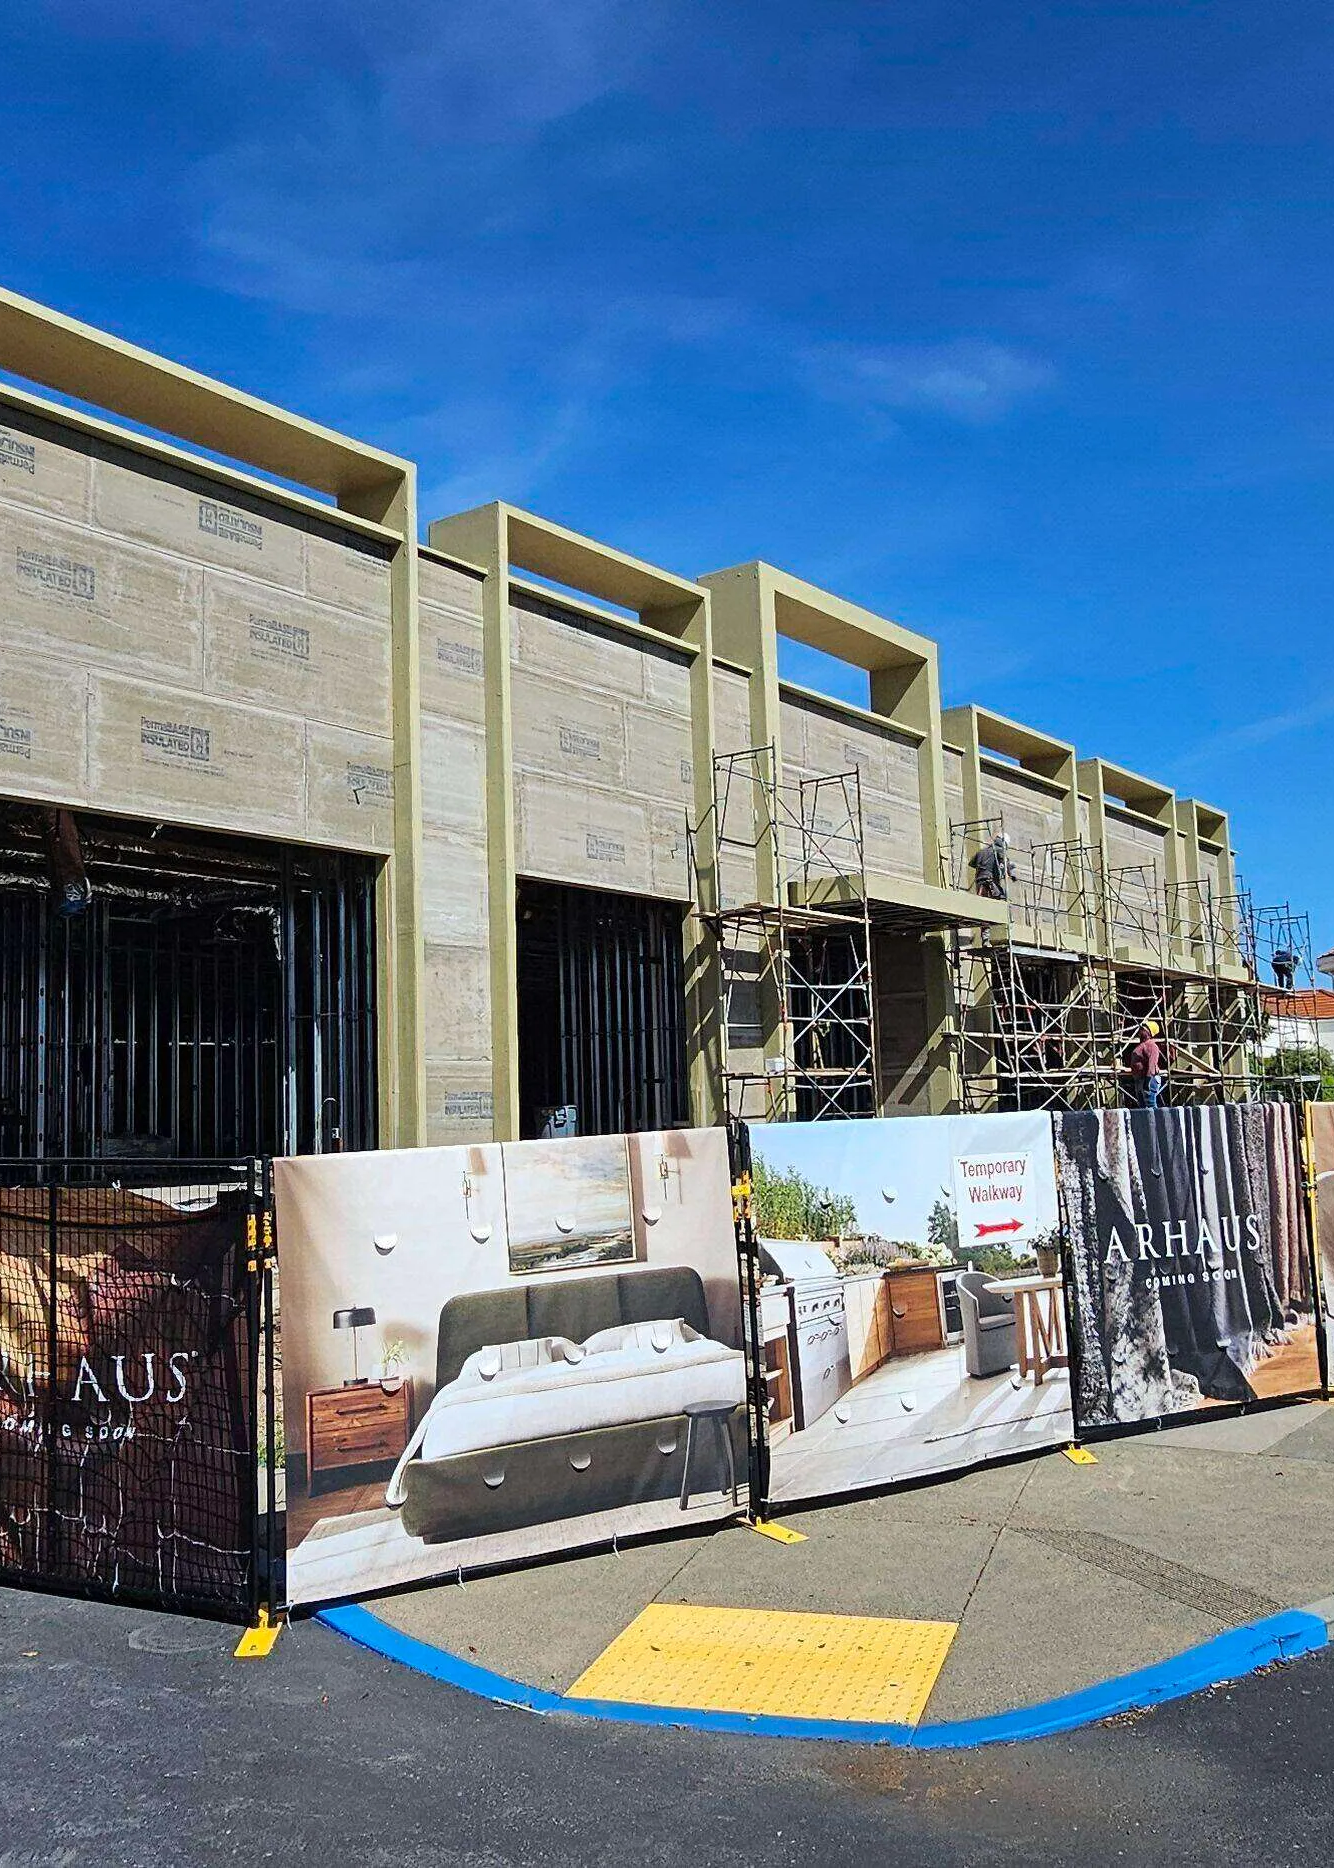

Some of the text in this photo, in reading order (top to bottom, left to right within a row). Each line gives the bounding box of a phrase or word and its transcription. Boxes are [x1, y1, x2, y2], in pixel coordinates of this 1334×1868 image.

[141, 716, 189, 736] PermaBASE
[959, 1159, 1026, 1179] Temporary
[968, 1184, 1022, 1203] Walkway
[1103, 1214, 1261, 1264] ARHAUS
[1146, 1269, 1238, 1290] COMING SOON
